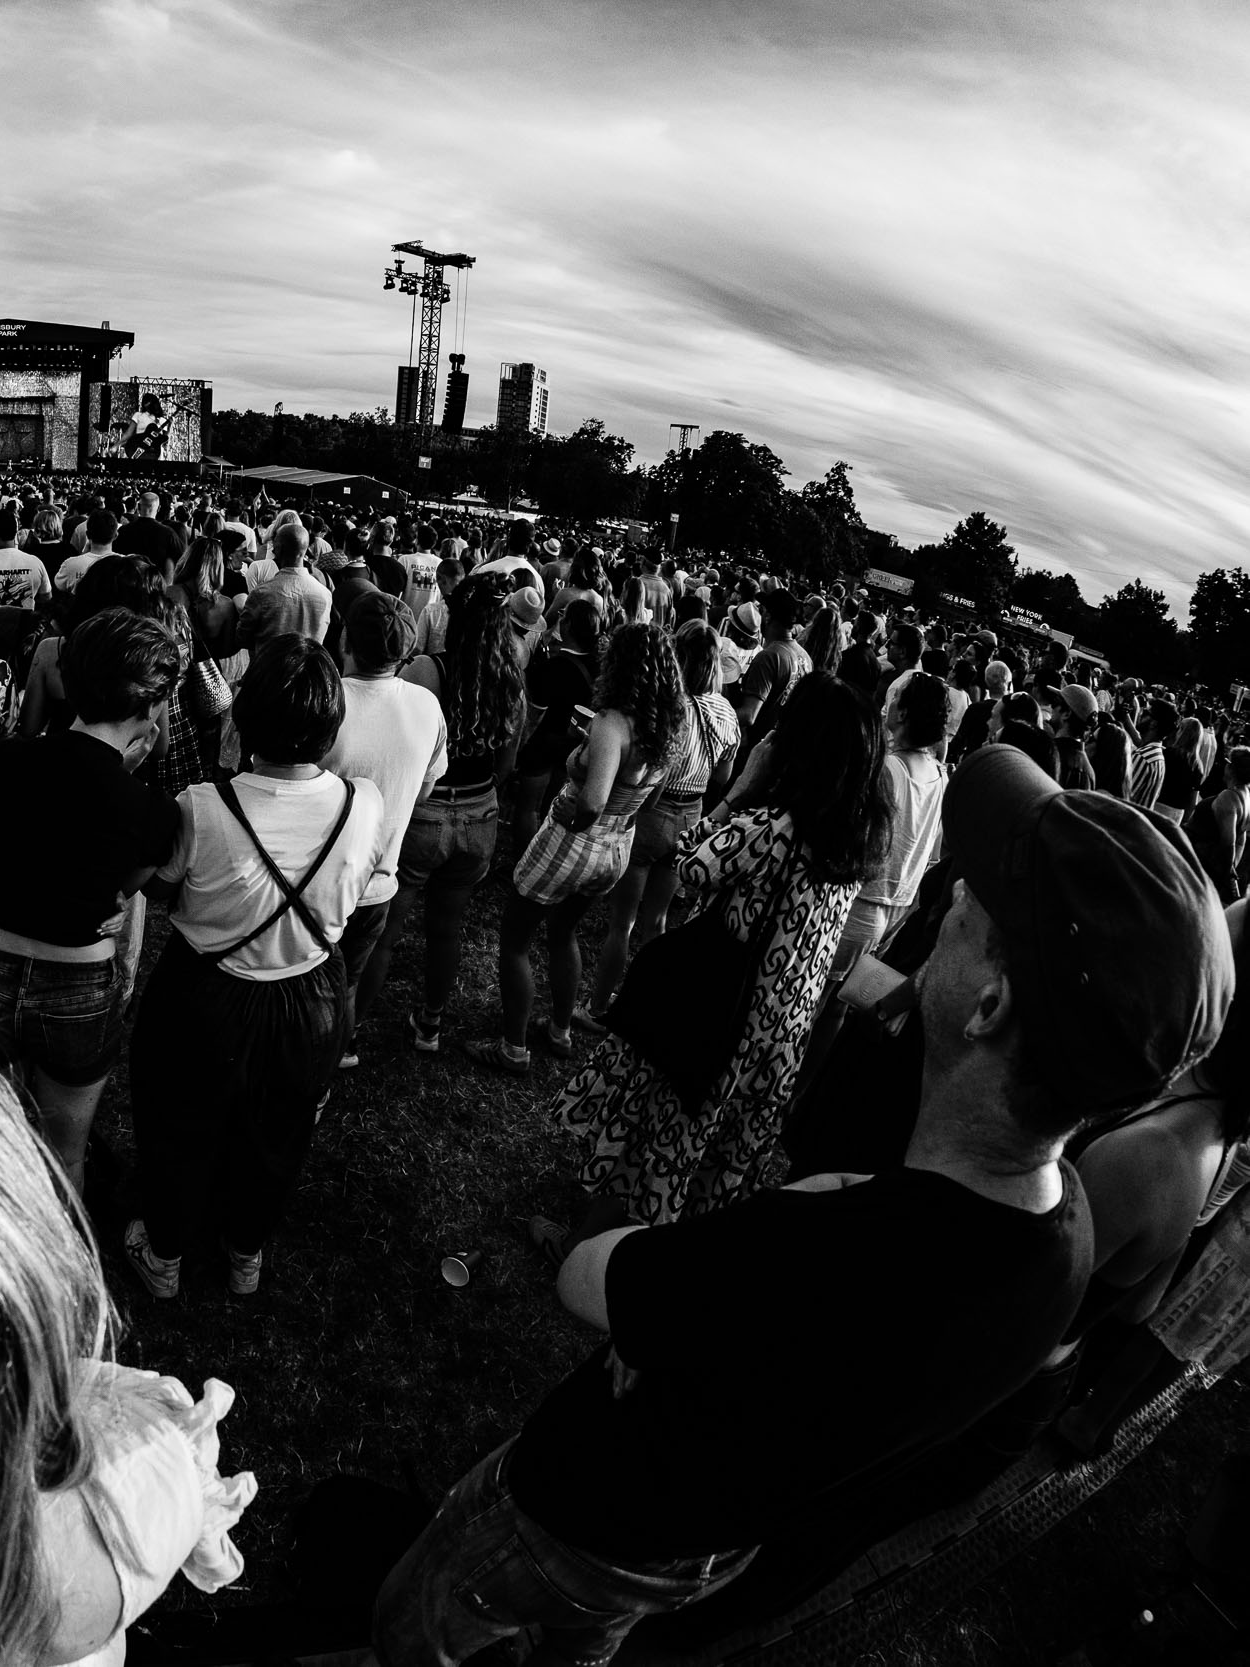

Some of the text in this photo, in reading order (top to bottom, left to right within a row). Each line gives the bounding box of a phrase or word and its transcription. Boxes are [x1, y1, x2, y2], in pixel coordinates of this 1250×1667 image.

[959, 597, 976, 609] FRIES
[1010, 605, 1044, 621] NEW YORK
[1016, 614, 1034, 625] FRIES
